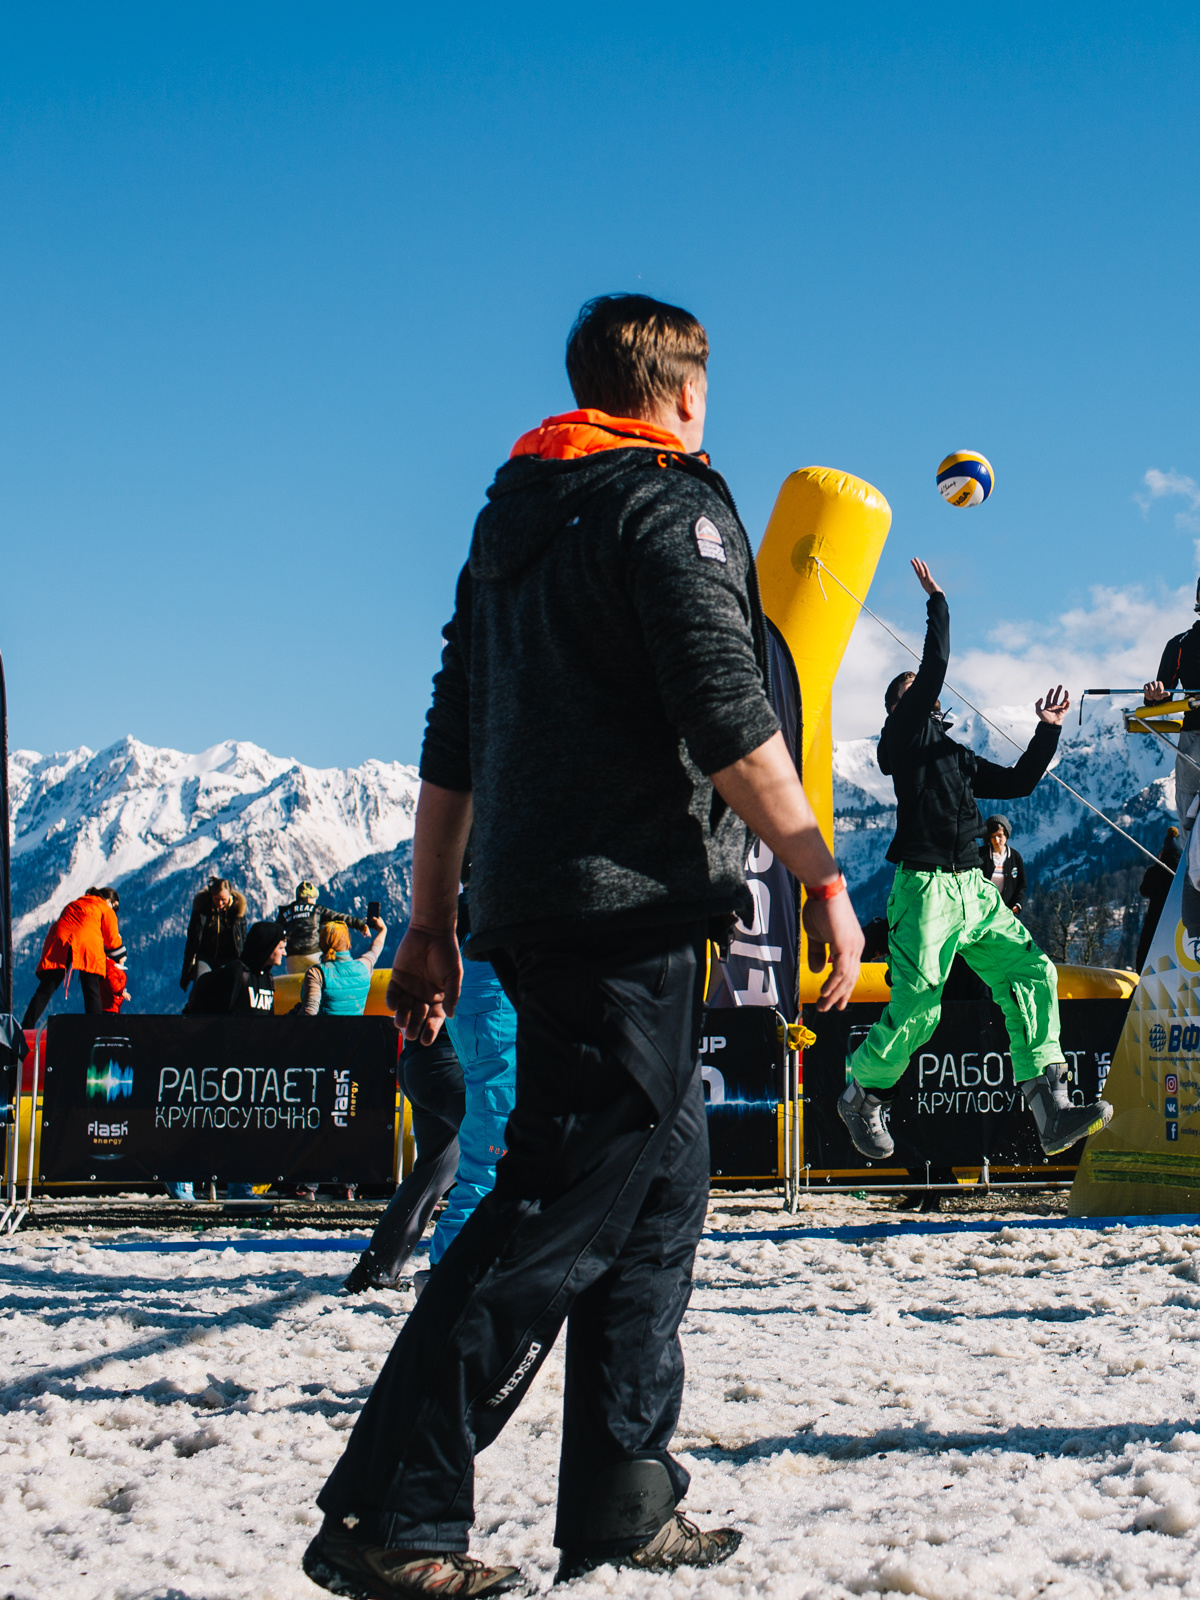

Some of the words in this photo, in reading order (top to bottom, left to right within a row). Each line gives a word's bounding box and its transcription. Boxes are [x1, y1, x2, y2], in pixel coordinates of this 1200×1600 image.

[158, 1066, 325, 1103] РАБОТАЕТ
[918, 1051, 1086, 1089] РАБОТ
[331, 1069, 350, 1127] flash
[350, 1081, 359, 1117] energy
[88, 1120, 128, 1136] flash
[155, 1106, 321, 1129] КРУГЛОСУТОЧНО
[489, 1145, 508, 1156] ROX
[486, 1341, 542, 1407] DESCENTE
